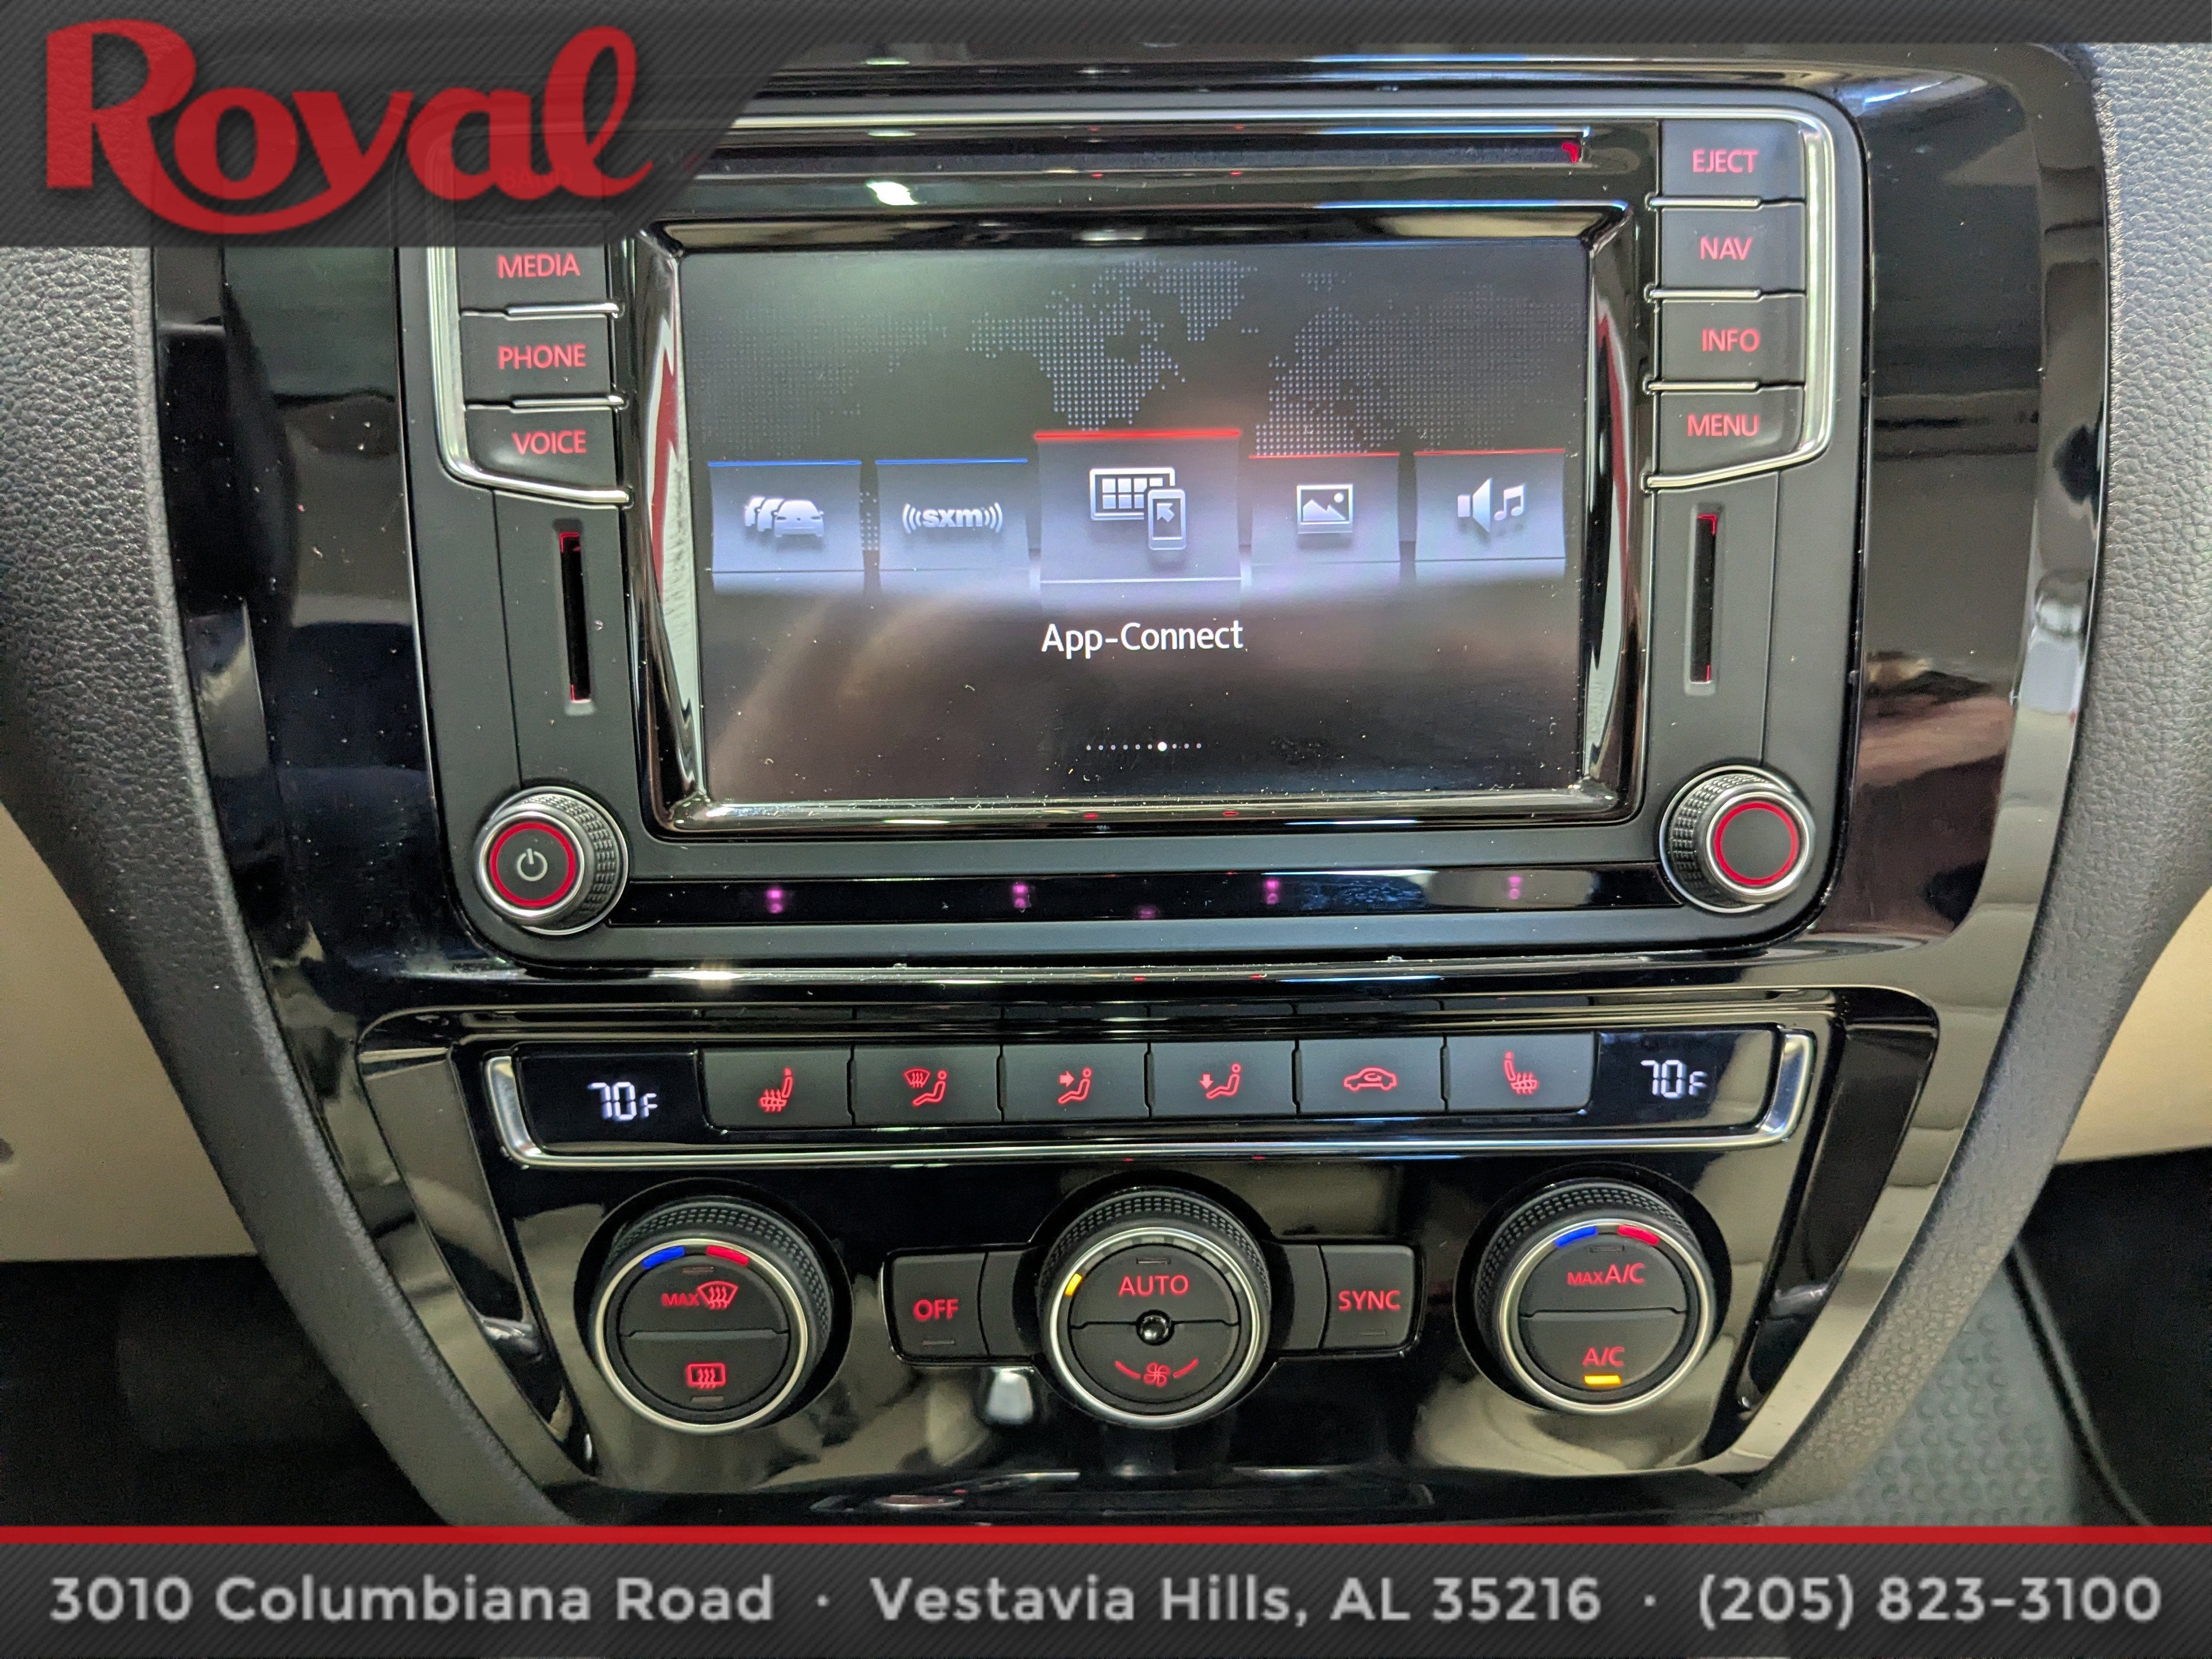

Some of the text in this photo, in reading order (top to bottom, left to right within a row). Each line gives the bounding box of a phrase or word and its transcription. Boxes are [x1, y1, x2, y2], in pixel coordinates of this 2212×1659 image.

[1692, 149, 1758, 173] EJECT
[1700, 237, 1752, 260] NAV
[497, 252, 580, 279] MEDIA
[1701, 328, 1760, 352] INFO
[498, 343, 586, 369] PHONE
[1686, 413, 1759, 437] MENU
[512, 429, 587, 455] VOICE
[1041, 619, 1244, 659] App-Connect
[1118, 1273, 1190, 1297] AUTO
[1566, 1262, 1645, 1285] MAX A/C
[662, 1292, 699, 1307] MAX
[912, 1297, 960, 1322] OFF
[1337, 1289, 1401, 1312] SYNC
[1581, 1346, 1624, 1367] A/C
